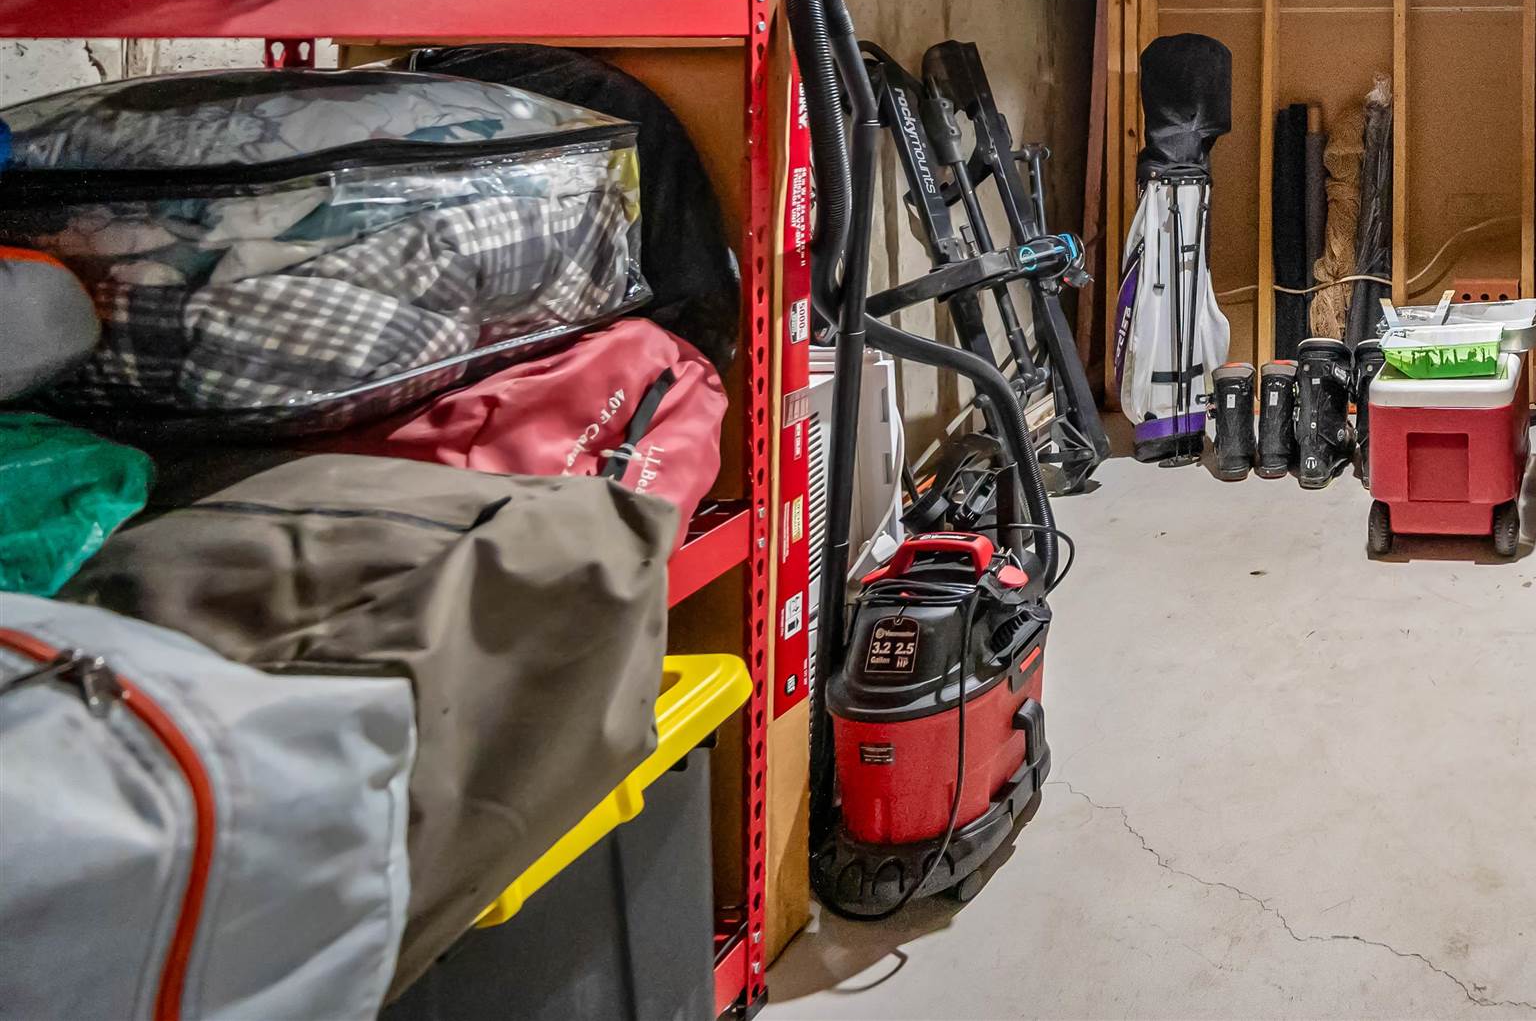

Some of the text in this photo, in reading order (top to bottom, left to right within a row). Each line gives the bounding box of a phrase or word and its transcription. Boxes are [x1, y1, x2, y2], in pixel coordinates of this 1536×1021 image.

[894, 87, 936, 195] rockymounts
[634, 446, 666, 495] L.L.Bea
[871, 641, 915, 655] 3.2 2.5
